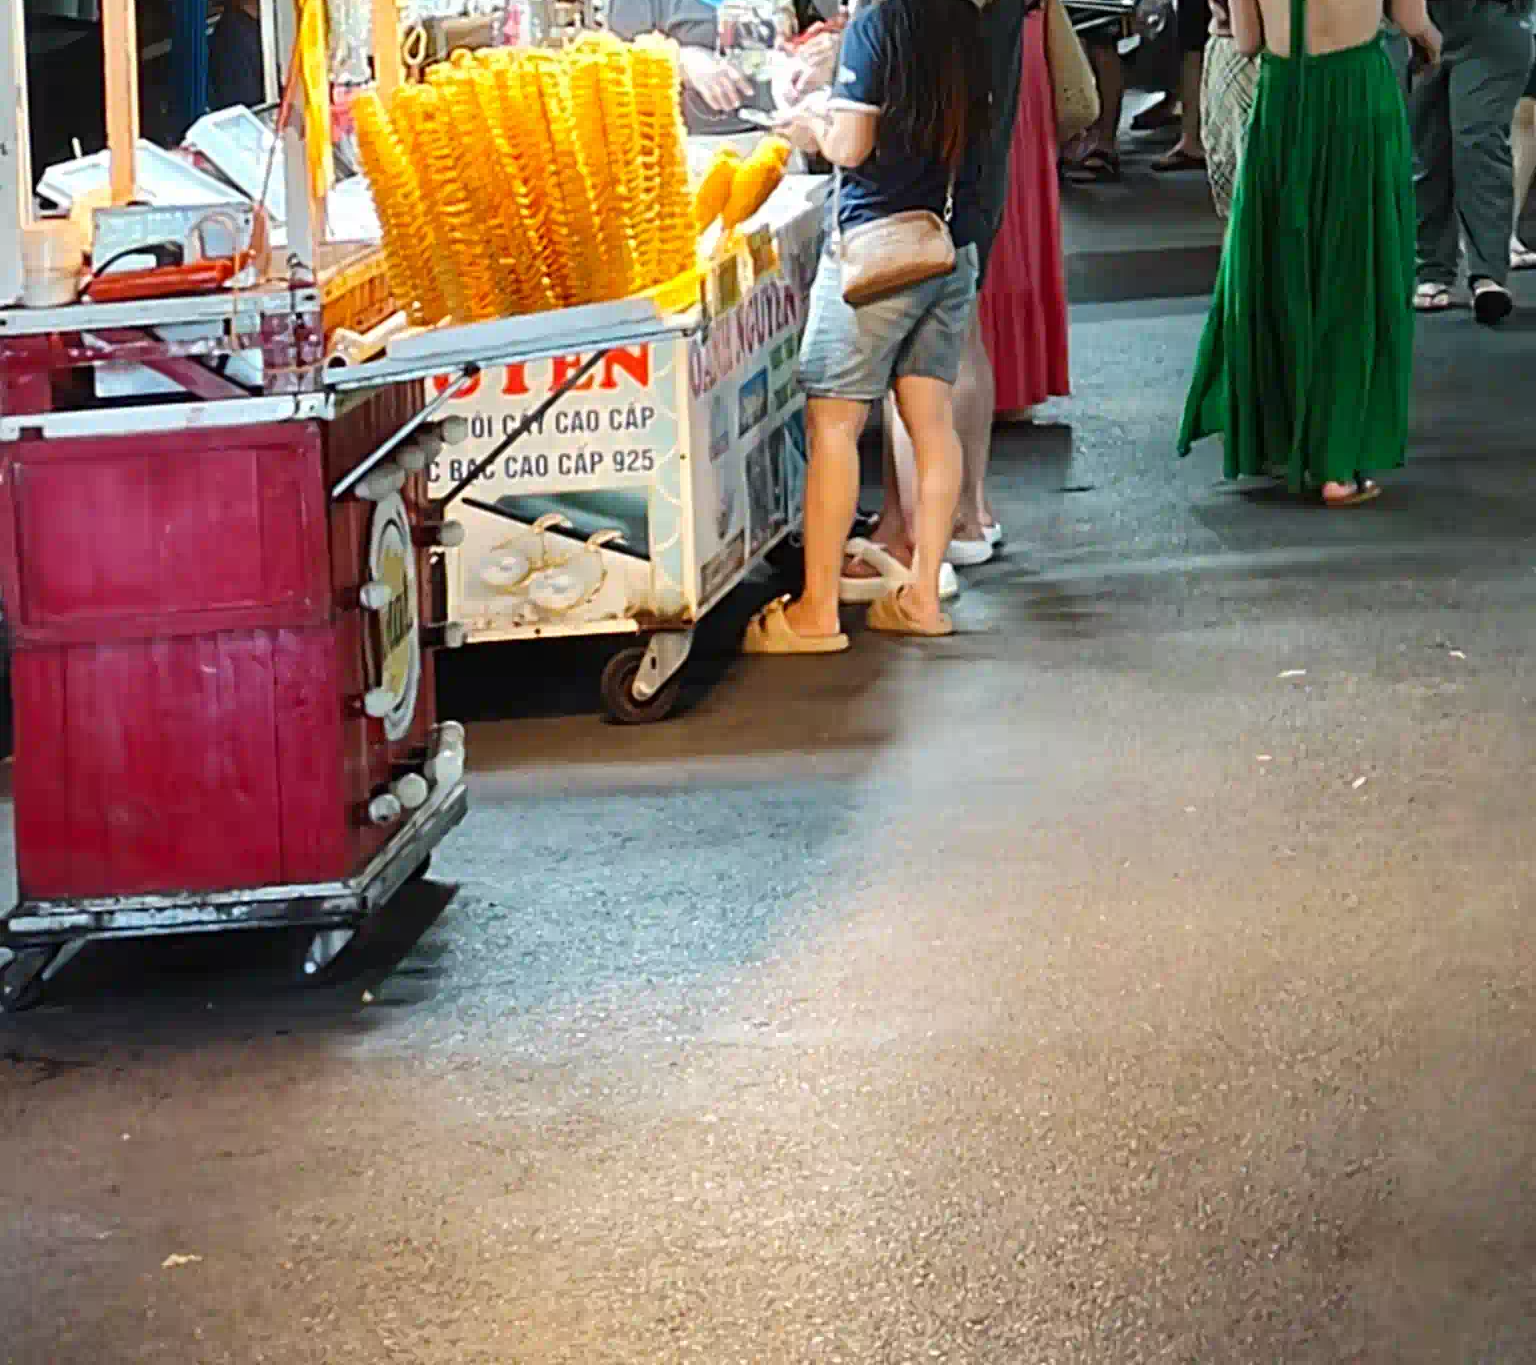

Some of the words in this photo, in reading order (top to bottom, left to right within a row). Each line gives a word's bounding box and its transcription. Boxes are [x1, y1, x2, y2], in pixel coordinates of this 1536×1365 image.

[555, 409, 600, 435] CAO
[504, 454, 549, 478] CAO
[612, 449, 655, 472] 925
